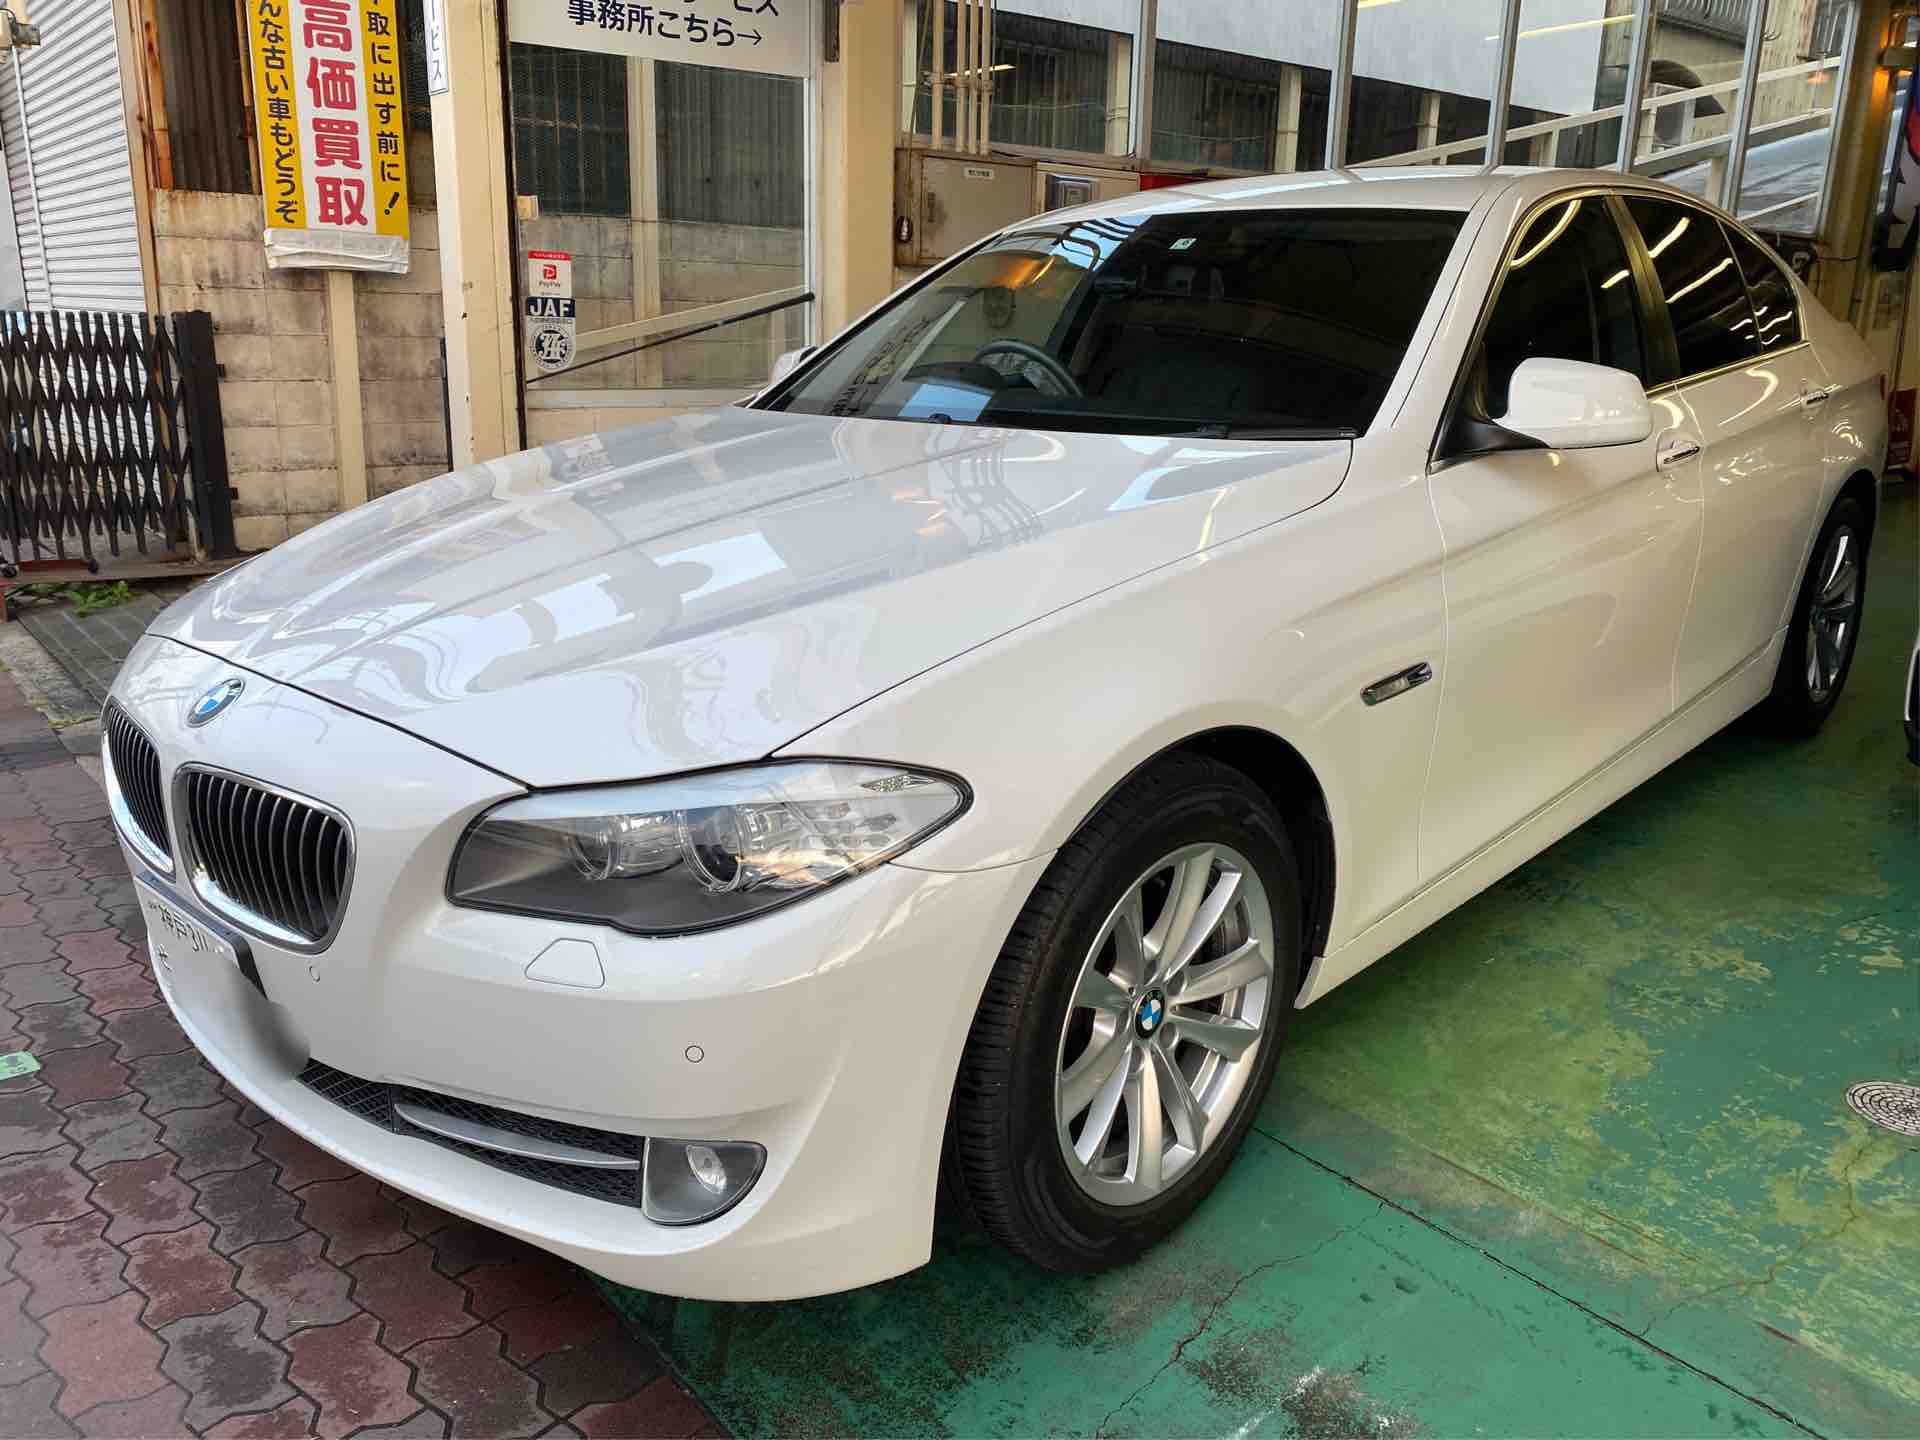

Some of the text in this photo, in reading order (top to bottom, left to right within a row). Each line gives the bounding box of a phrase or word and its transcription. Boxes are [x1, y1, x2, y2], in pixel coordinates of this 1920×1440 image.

[567, 0, 735, 46] 事務所こちら
[300, 0, 368, 226] 高価買取
[366, 0, 400, 216] 取に出す前に!
[529, 299, 571, 317] JAF
